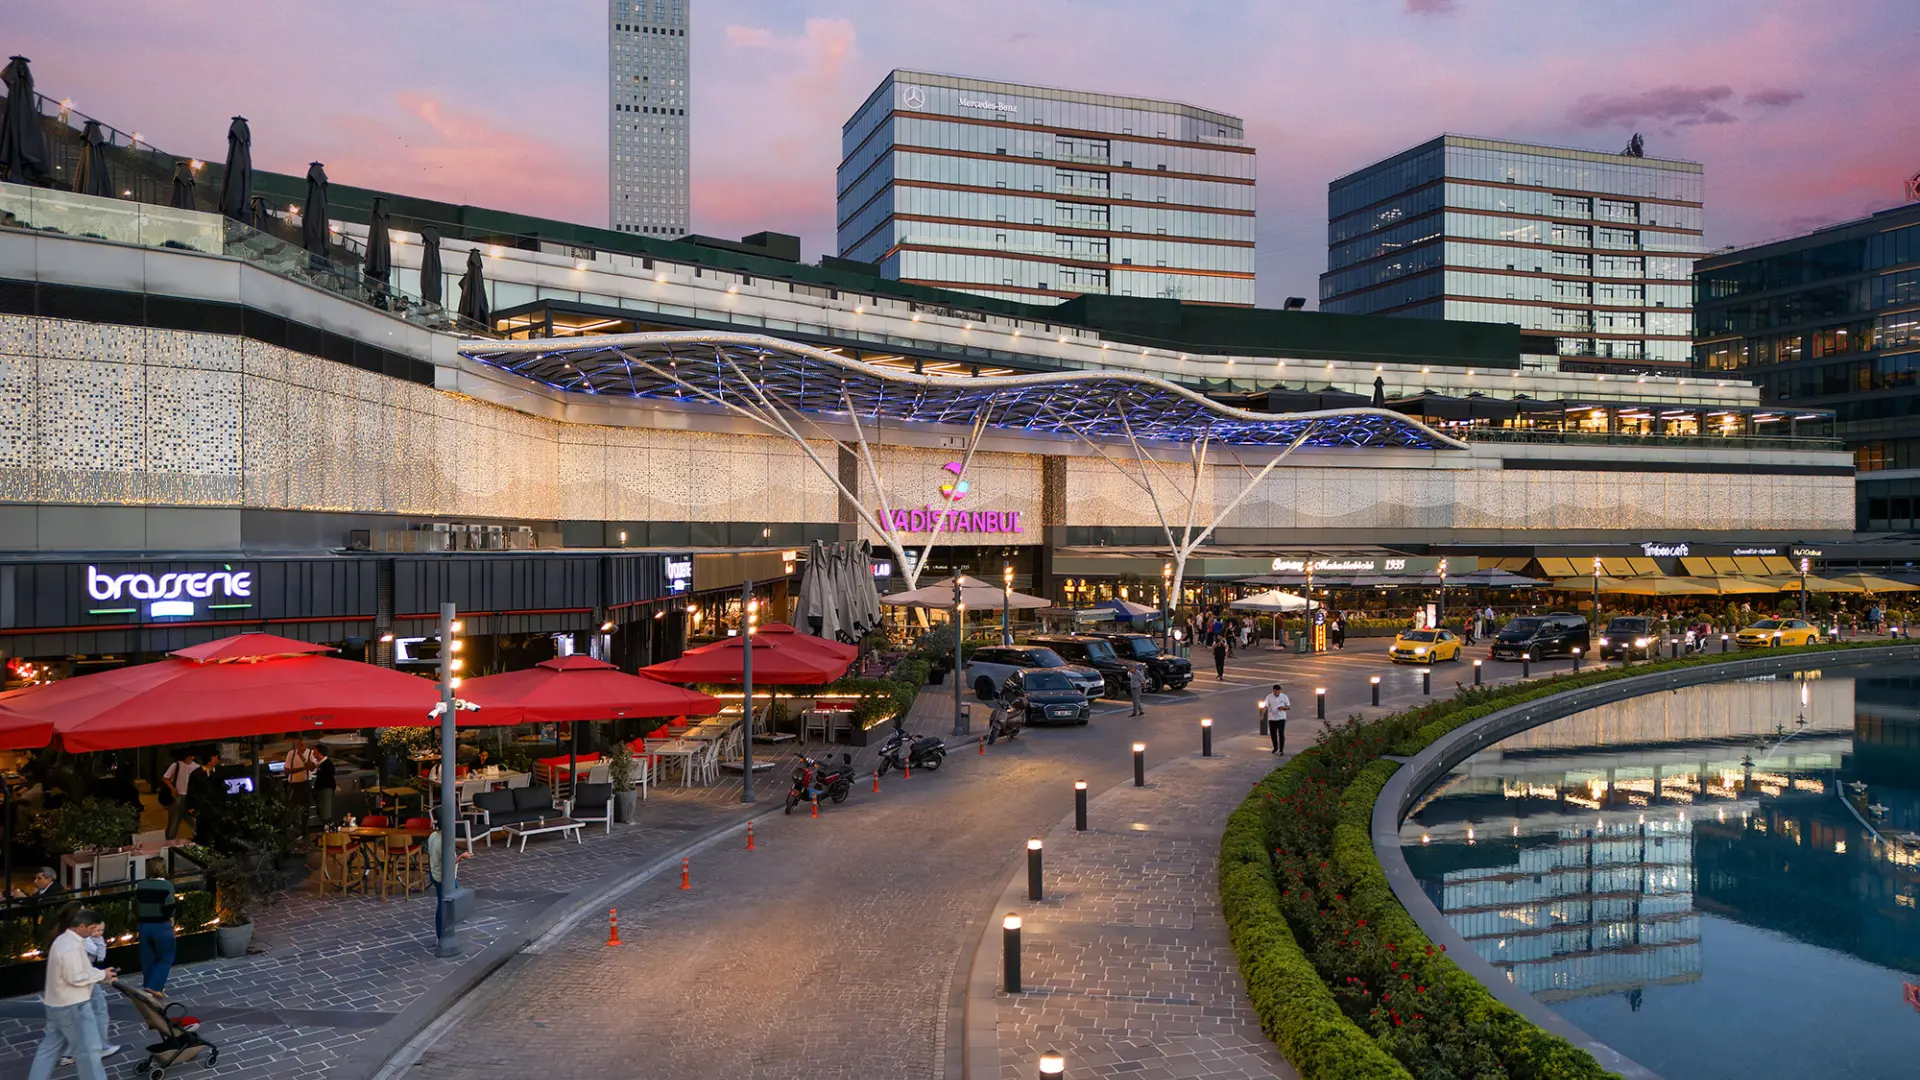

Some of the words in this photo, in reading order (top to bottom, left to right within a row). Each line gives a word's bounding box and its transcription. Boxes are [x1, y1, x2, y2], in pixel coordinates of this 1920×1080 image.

[958, 97, 1018, 112] Mercedes-Benz
[879, 503, 1025, 533] VADİSTANBUL
[1385, 559, 1406, 570] 1935
[88, 563, 251, 600] brasserie
